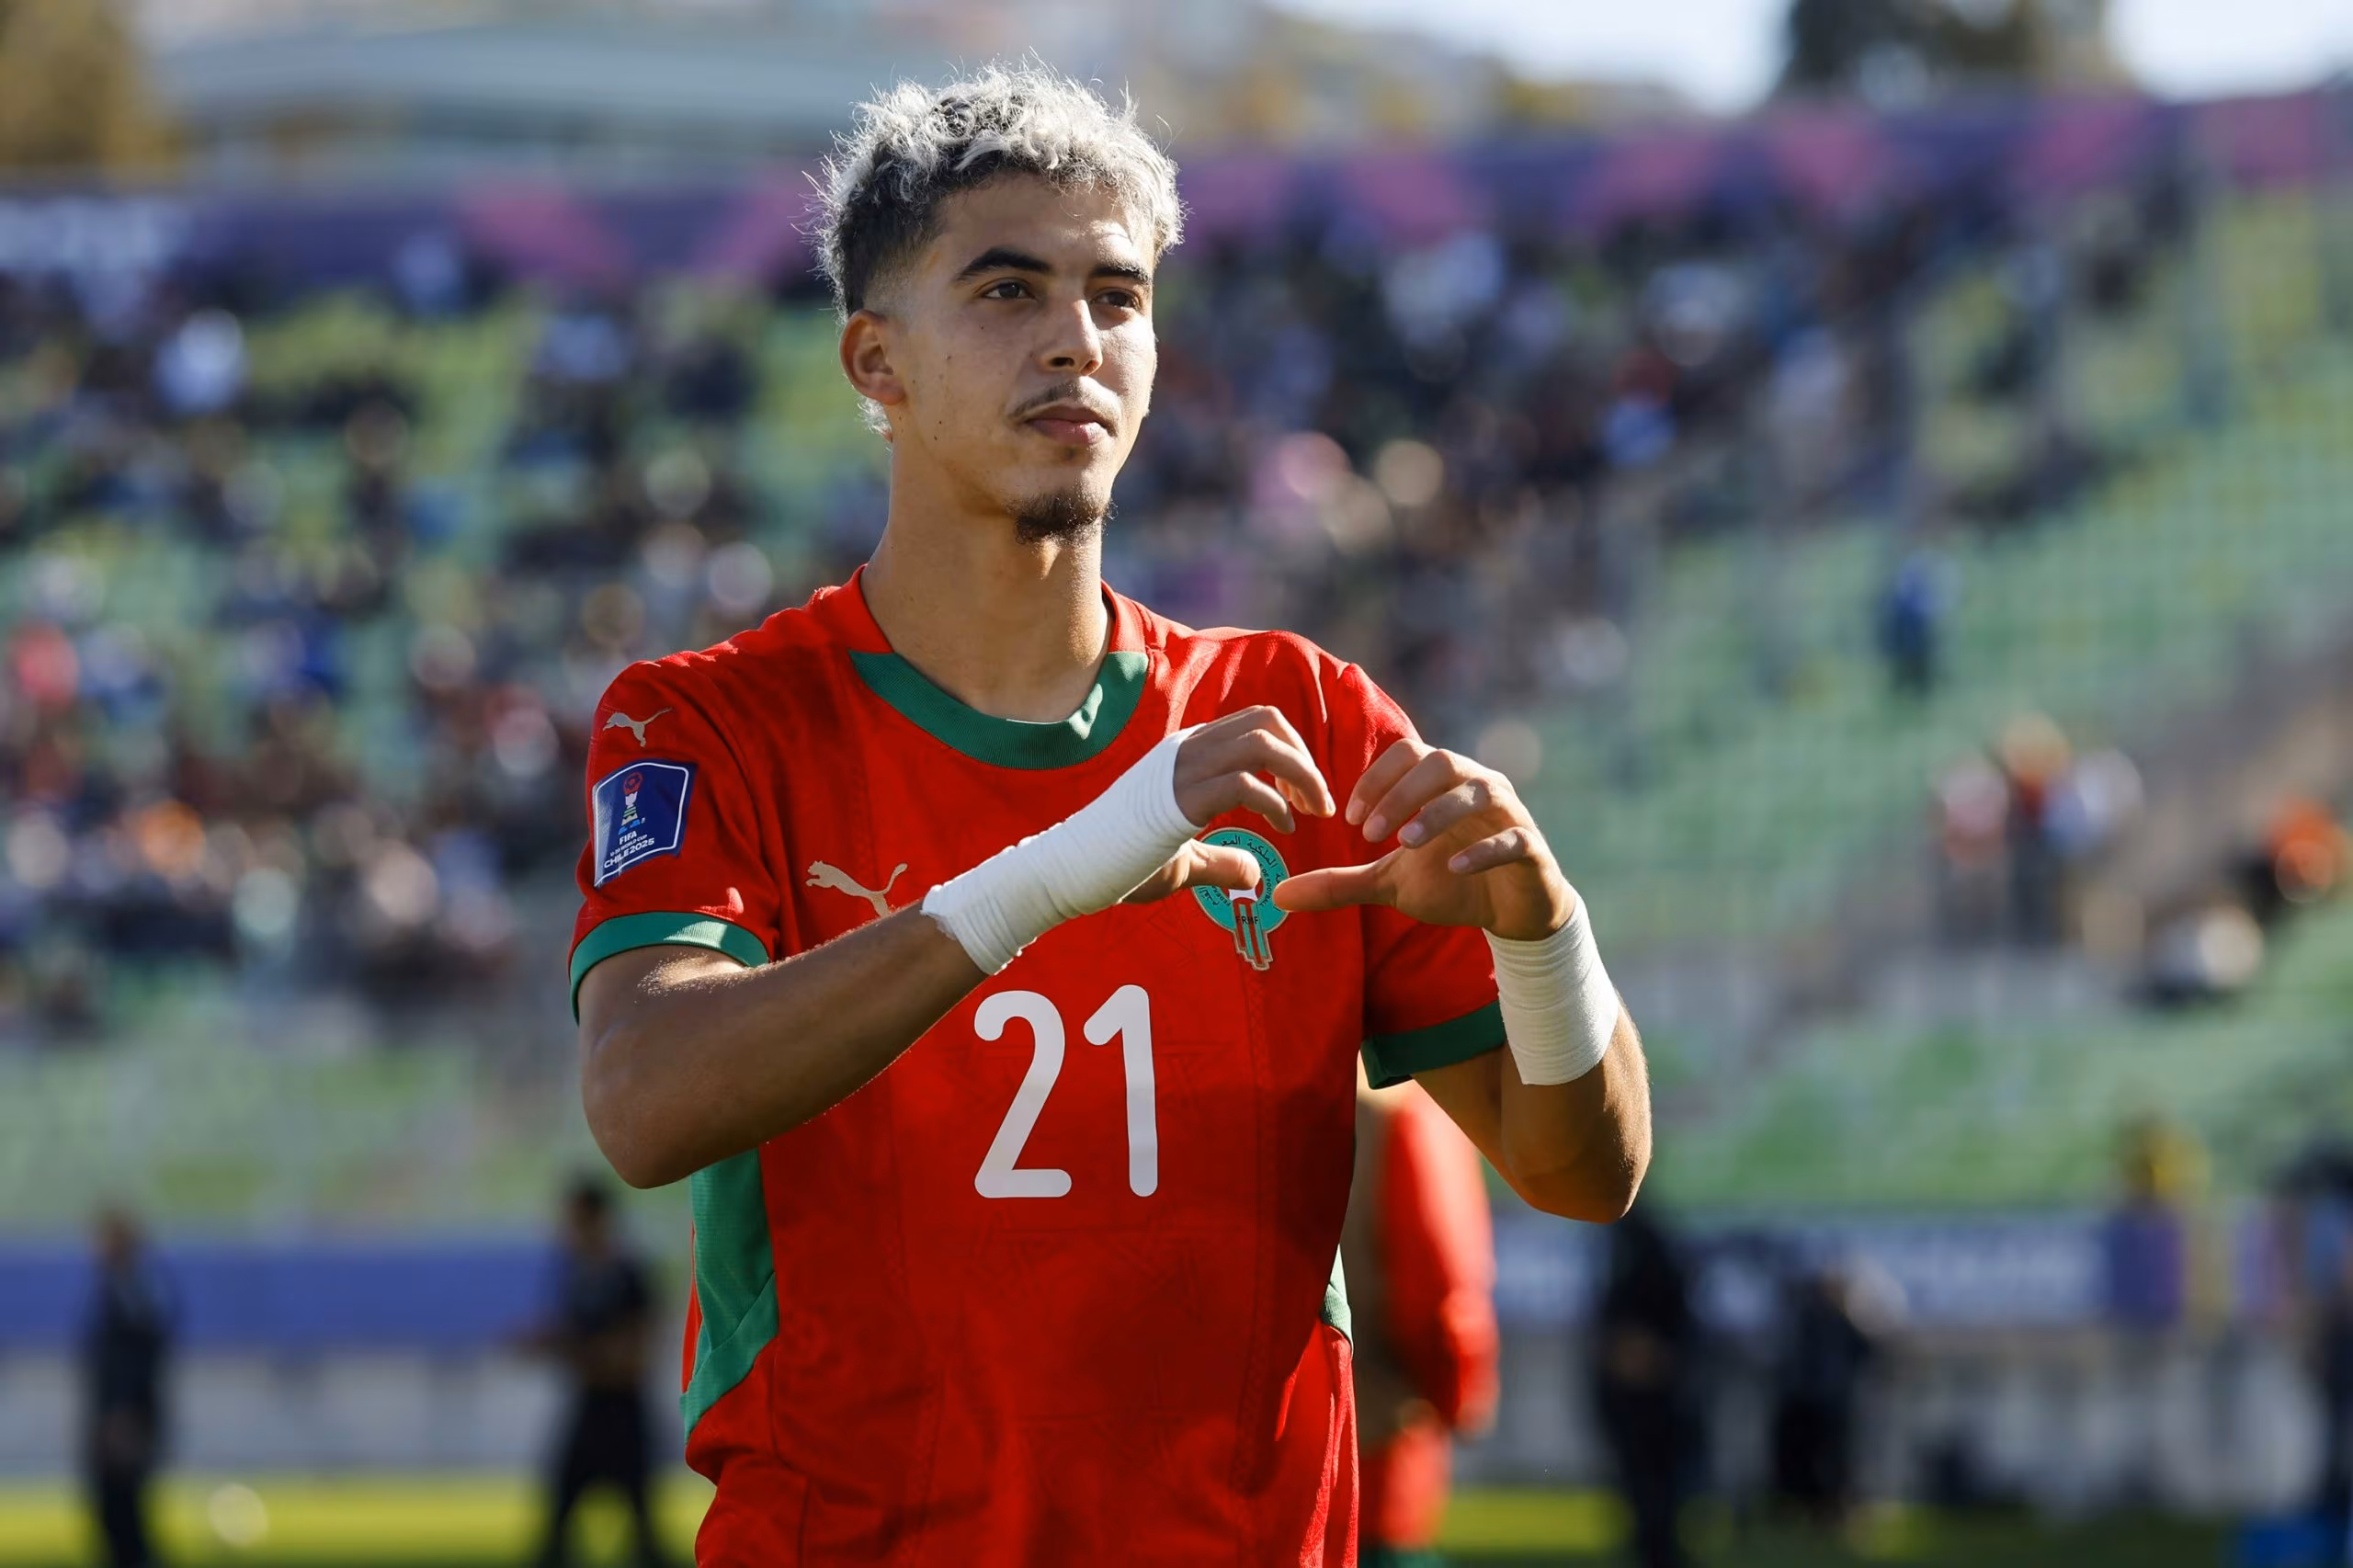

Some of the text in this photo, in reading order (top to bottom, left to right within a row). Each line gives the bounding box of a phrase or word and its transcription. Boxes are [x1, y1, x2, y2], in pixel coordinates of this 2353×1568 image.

[619, 830, 637, 845] FIFA
[620, 838, 637, 850] WORLD
[637, 834, 648, 842] CUP
[974, 984, 1158, 1199] 21
